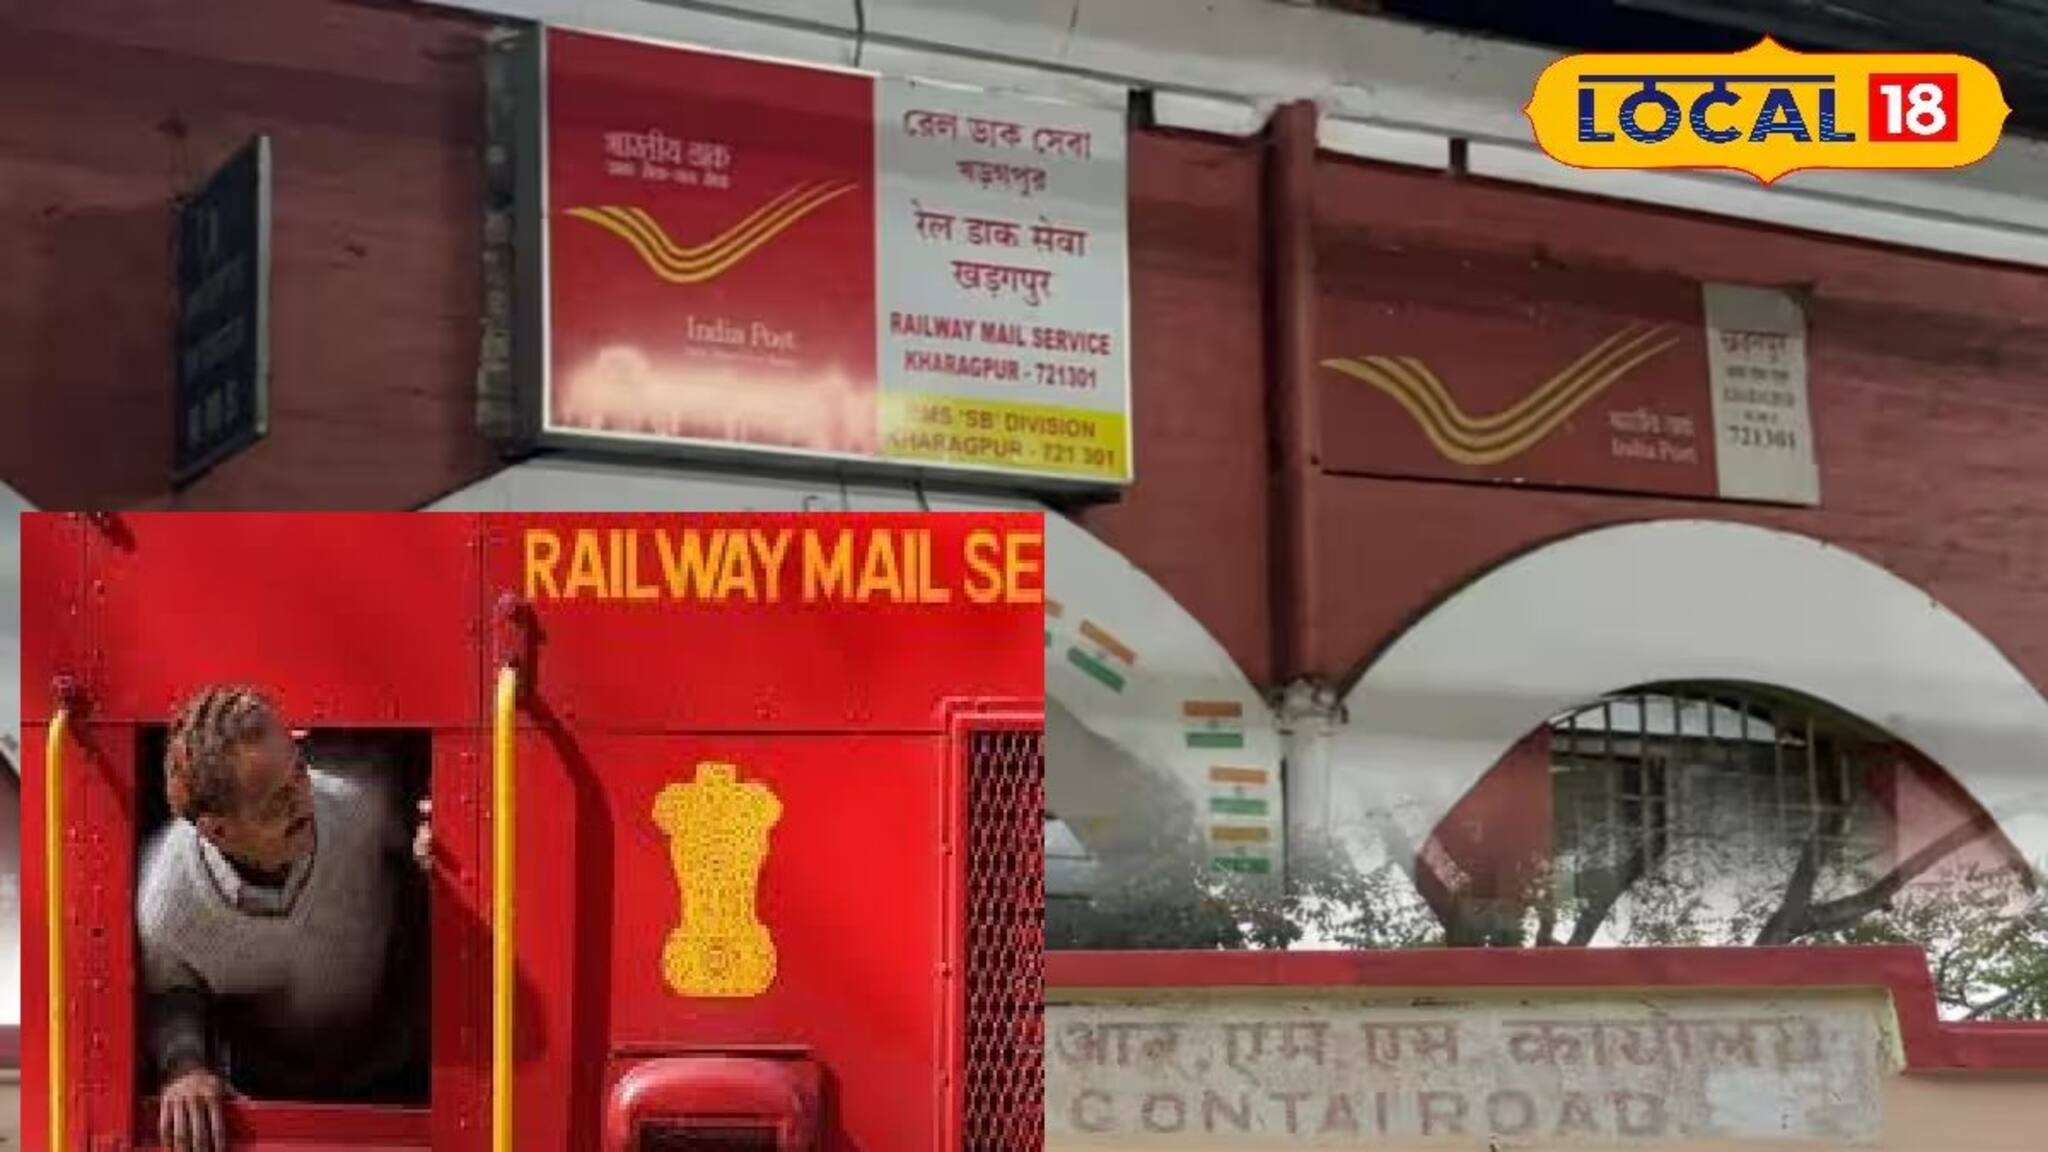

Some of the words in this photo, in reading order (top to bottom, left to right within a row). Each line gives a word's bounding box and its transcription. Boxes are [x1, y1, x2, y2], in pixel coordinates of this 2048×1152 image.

[910, 199, 956, 241] रेल
[963, 217, 1020, 247] डाक
[1031, 215, 1088, 257] सेवा
[951, 260, 1055, 306] खड़गपुर
[685, 313, 745, 345] India
[750, 320, 796, 351] Post
[889, 311, 976, 342] RAILWAY
[980, 321, 1028, 348] MAIL
[1031, 326, 1112, 356] SERVICE
[904, 350, 1021, 381] KHARAGPUR
[1034, 362, 1099, 389] 721301
[1004, 412, 1098, 438] DIVISION
[1042, 442, 1077, 464] 721
[523, 528, 793, 602] RAILWAY
[802, 529, 951, 604] MAIL
[964, 533, 1044, 604] SE
